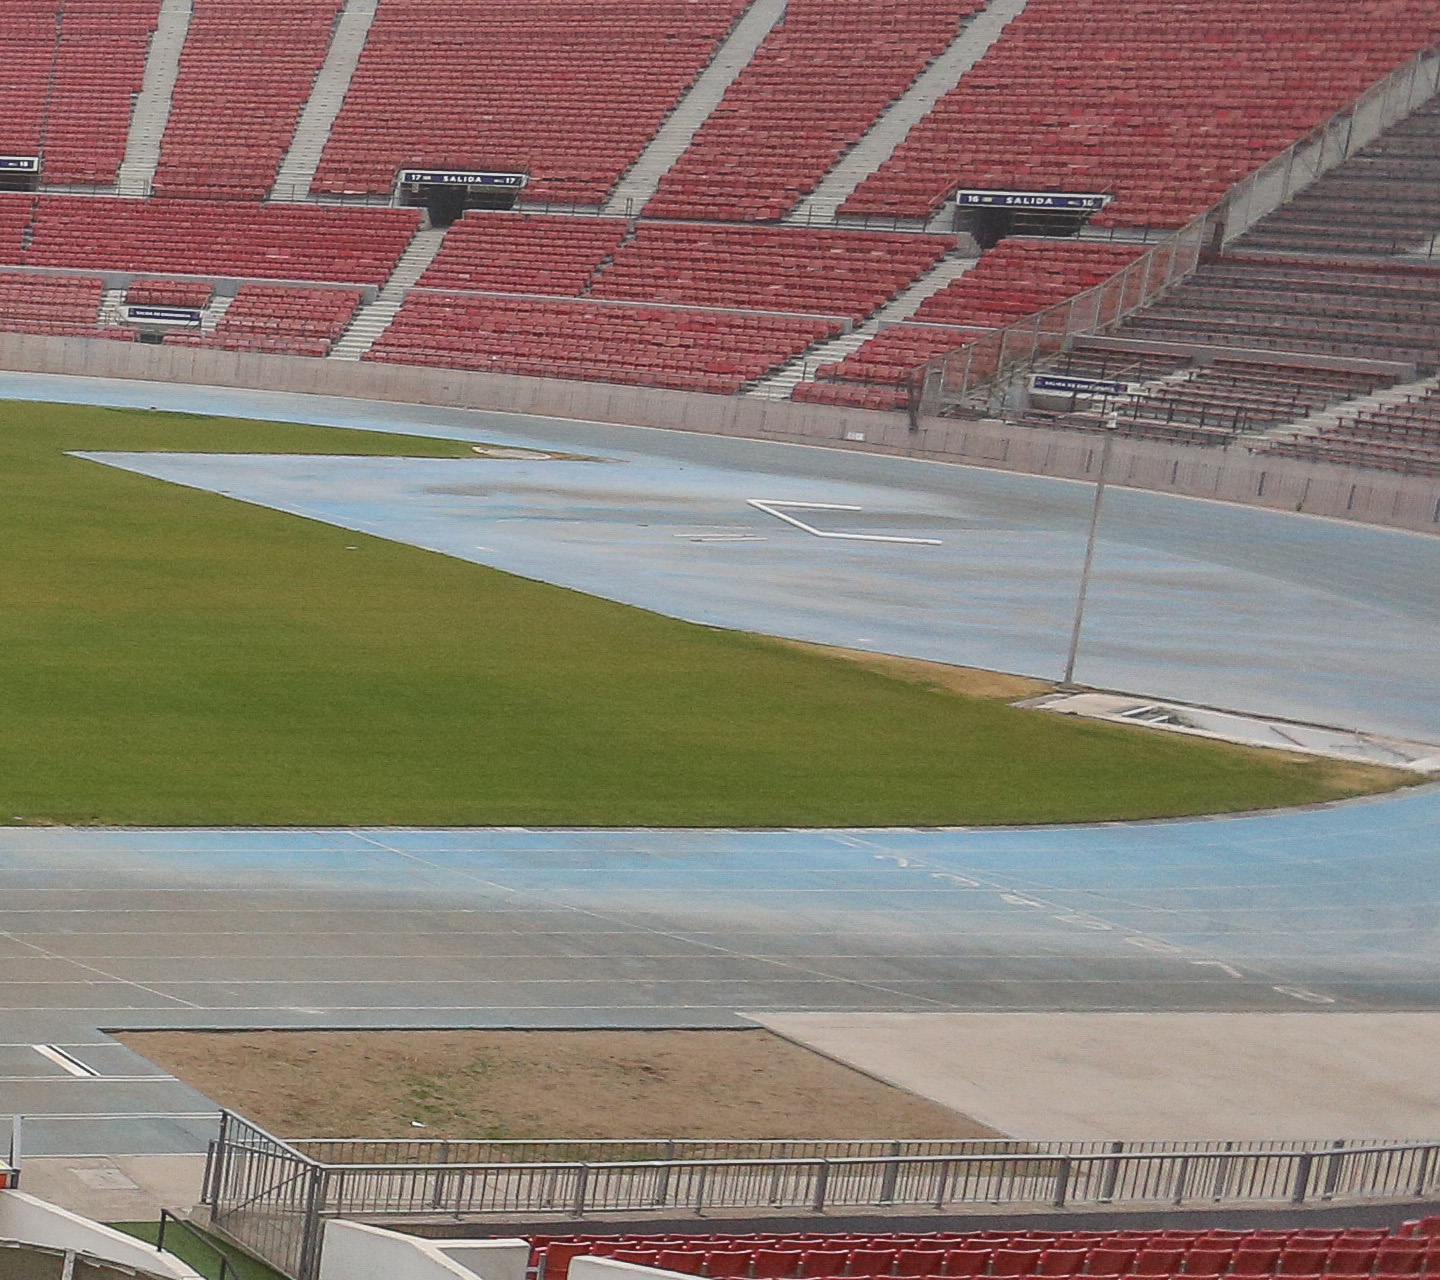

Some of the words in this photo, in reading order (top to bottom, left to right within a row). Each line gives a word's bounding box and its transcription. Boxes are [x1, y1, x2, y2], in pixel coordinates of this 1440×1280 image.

[443, 175, 483, 183] SALIDA
[967, 195, 980, 203] 16
[1005, 197, 1054, 206] SALIDA
